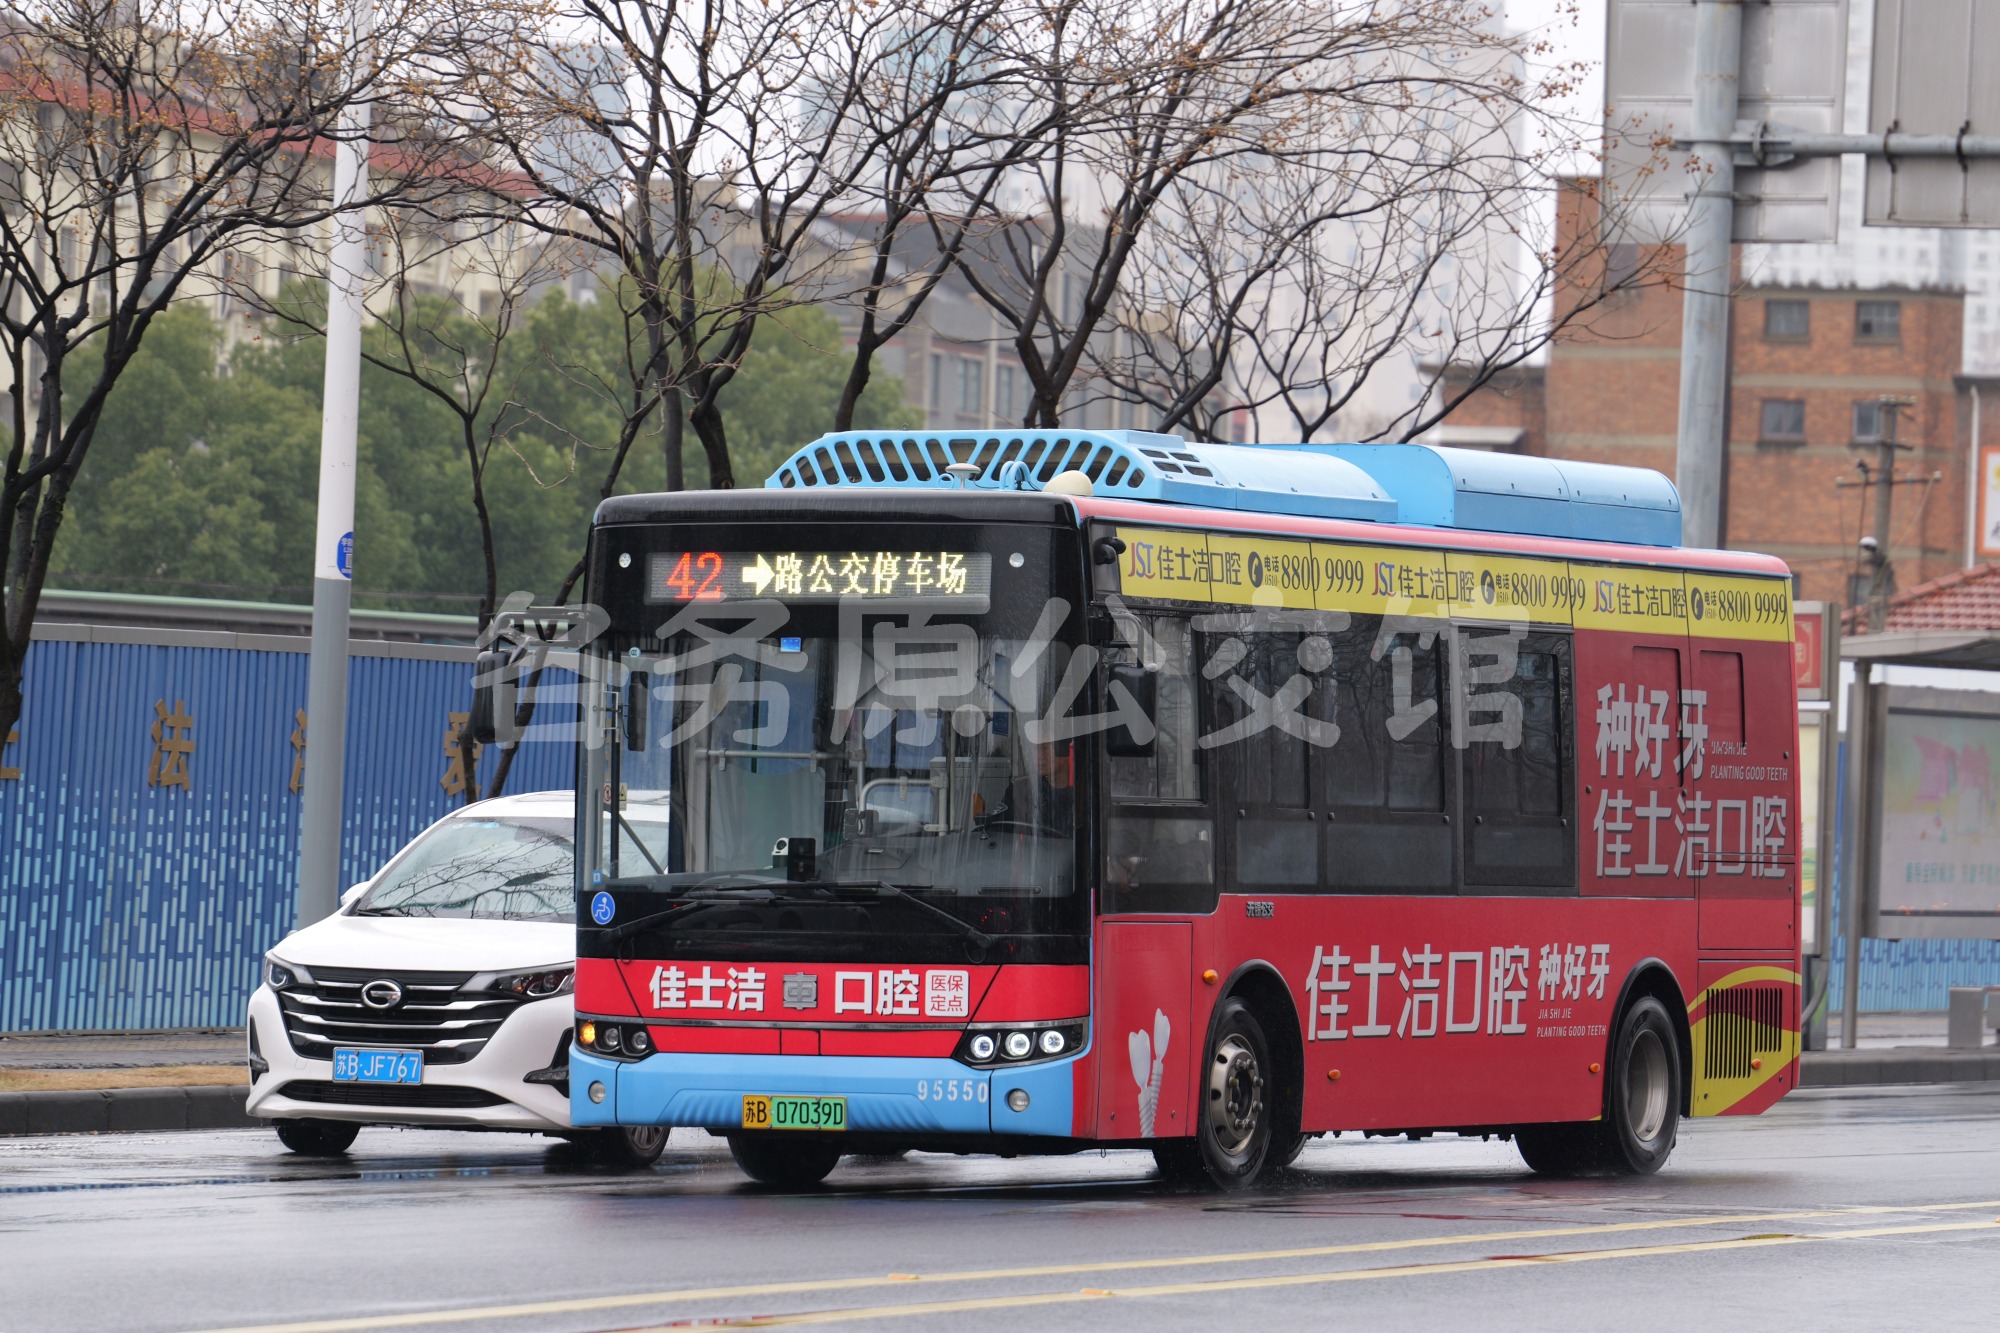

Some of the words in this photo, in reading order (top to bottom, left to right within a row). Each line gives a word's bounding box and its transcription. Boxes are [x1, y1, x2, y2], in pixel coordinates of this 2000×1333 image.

[666, 552, 722, 599] 42
[775, 552, 967, 594] 路公交停车场
[1127, 541, 1156, 579] JST
[1157, 545, 1242, 585] 佳士洁口腔
[1264, 554, 1280, 573] 电话
[1281, 554, 1321, 592] 8800
[1325, 558, 1364, 594] 9999
[1372, 561, 1397, 597] JST
[1398, 564, 1476, 603] 佳士洁口腔
[1496, 573, 1510, 590] 电话
[1511, 572, 1547, 608] 8800
[1551, 575, 1586, 611] 9999
[1593, 579, 1616, 614] JST
[1617, 582, 1686, 619] 佳士洁口腔
[1704, 590, 1717, 606] 电话
[1718, 589, 1751, 623] 8800
[1754, 592, 1787, 625] 9999
[1596, 682, 1709, 780] 种好牙
[1710, 765, 1744, 779] PLANTING
[1745, 766, 1765, 781] GOOD
[1766, 767, 1788, 781] TEETH
[1593, 788, 1787, 879] 佳士洁口腔
[649, 965, 766, 1012] 佳士洁
[834, 968, 921, 1016] 口腔
[931, 974, 964, 992] 医保
[1537, 942, 1610, 1001] 种好牙
[930, 994, 964, 1012] 定点
[1305, 943, 1530, 1042] 佳士洁口腔
[1536, 1026, 1567, 1038] PLANTING
[1568, 1026, 1586, 1037] GOOD
[1587, 1025, 1607, 1036] TEETH
[1538, 1008, 1548, 1020] JIA
[1549, 1008, 1561, 1020] SHI
[1561, 1007, 1572, 1019] JIE
[917, 1079, 989, 1104] 95550
